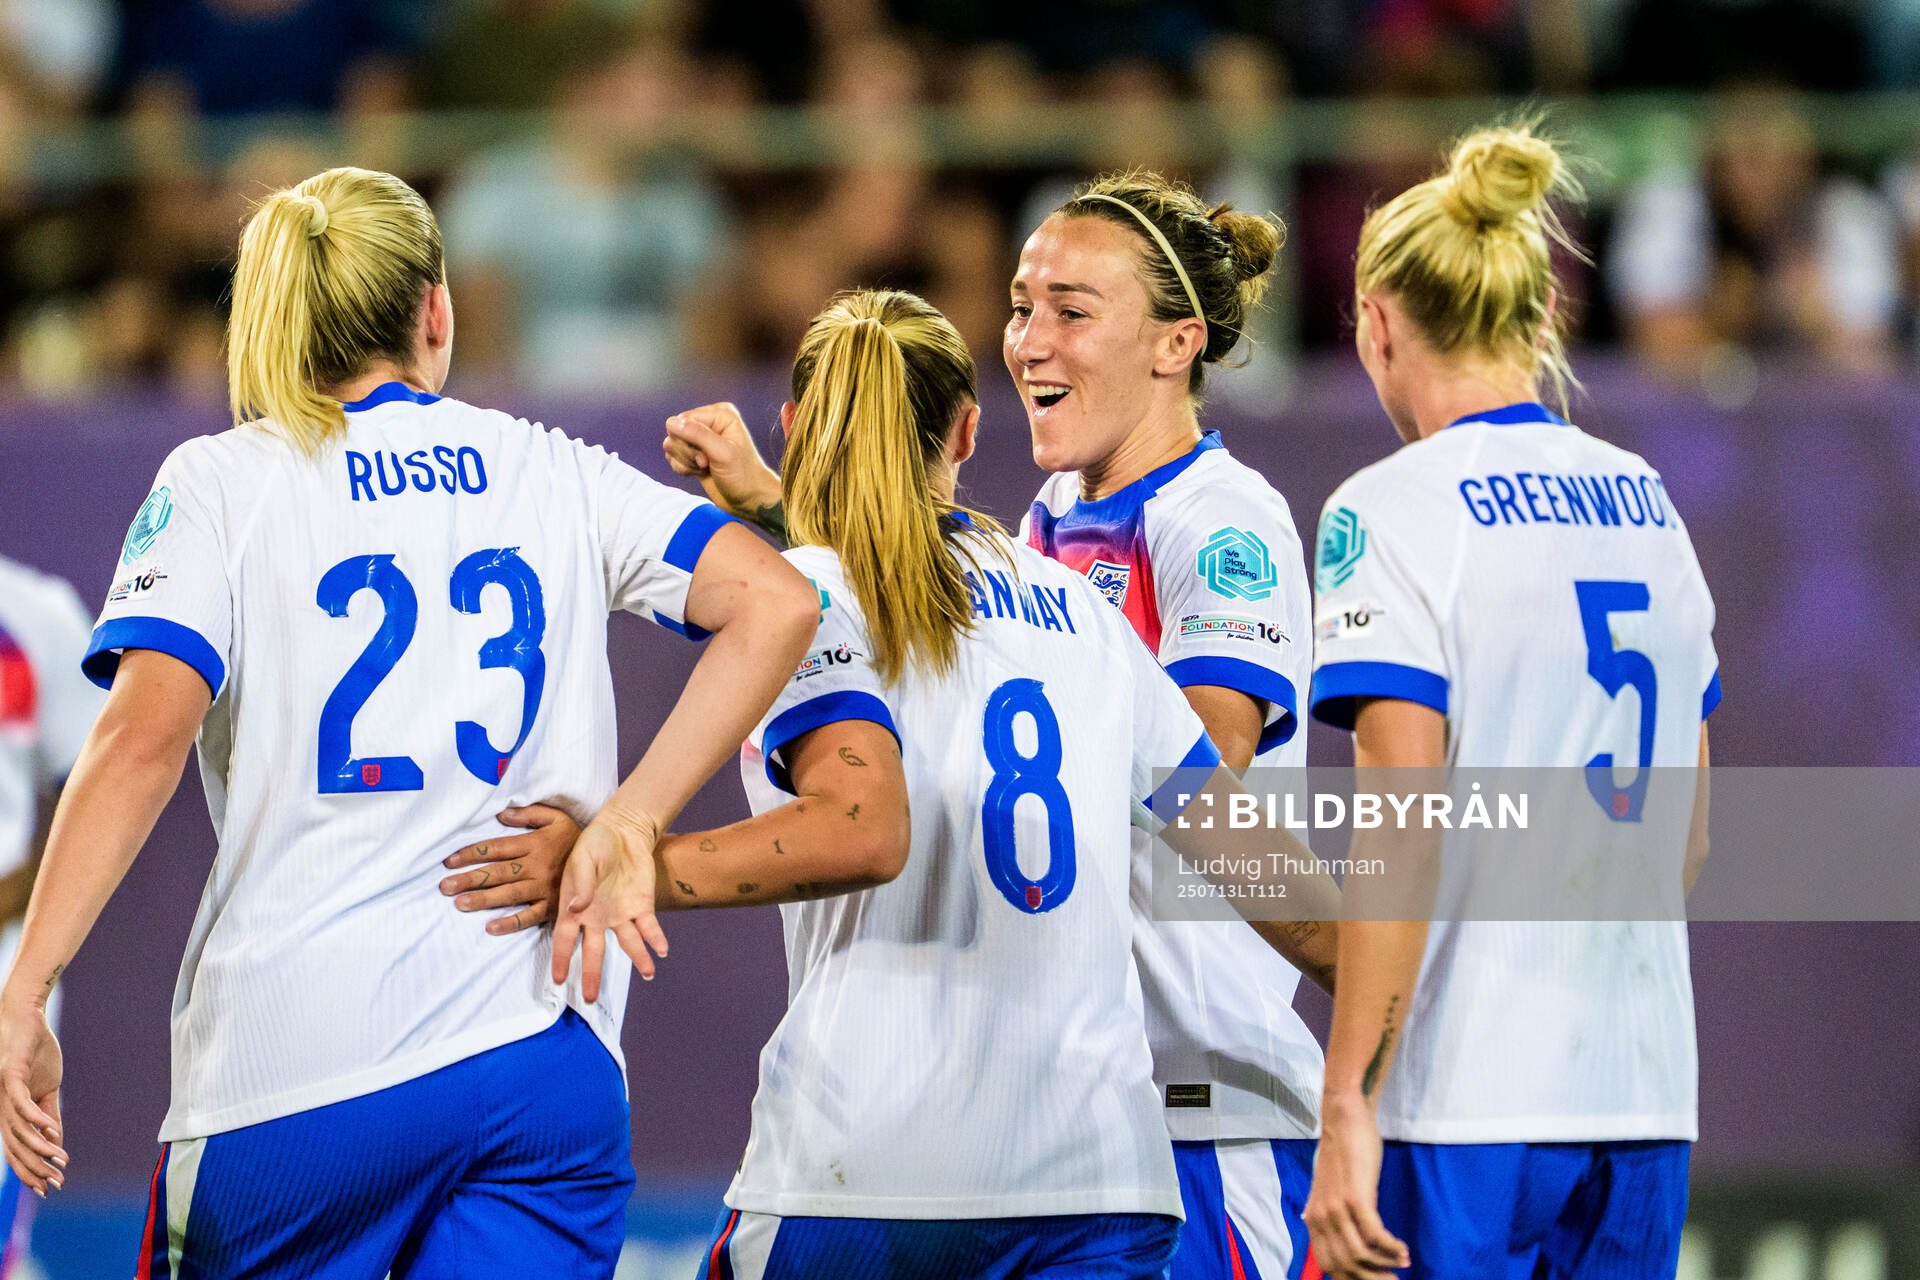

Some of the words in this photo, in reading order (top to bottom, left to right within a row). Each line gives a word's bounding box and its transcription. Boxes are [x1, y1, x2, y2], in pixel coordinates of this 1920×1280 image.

[345, 445, 488, 501] RUSSO
[1224, 548, 1240, 558] We
[1224, 557, 1247, 570] Play
[1224, 566, 1258, 581] Strong
[134, 574, 155, 593] 10
[963, 568, 1077, 635] ANWAY
[1180, 620, 1255, 633] FOUNDATION
[1343, 610, 1370, 629] 10
[1257, 621, 1281, 644] 10
[821, 648, 852, 665] 10
[316, 546, 547, 794] 23
[1573, 579, 1658, 823] 5
[981, 677, 1077, 915] 8
